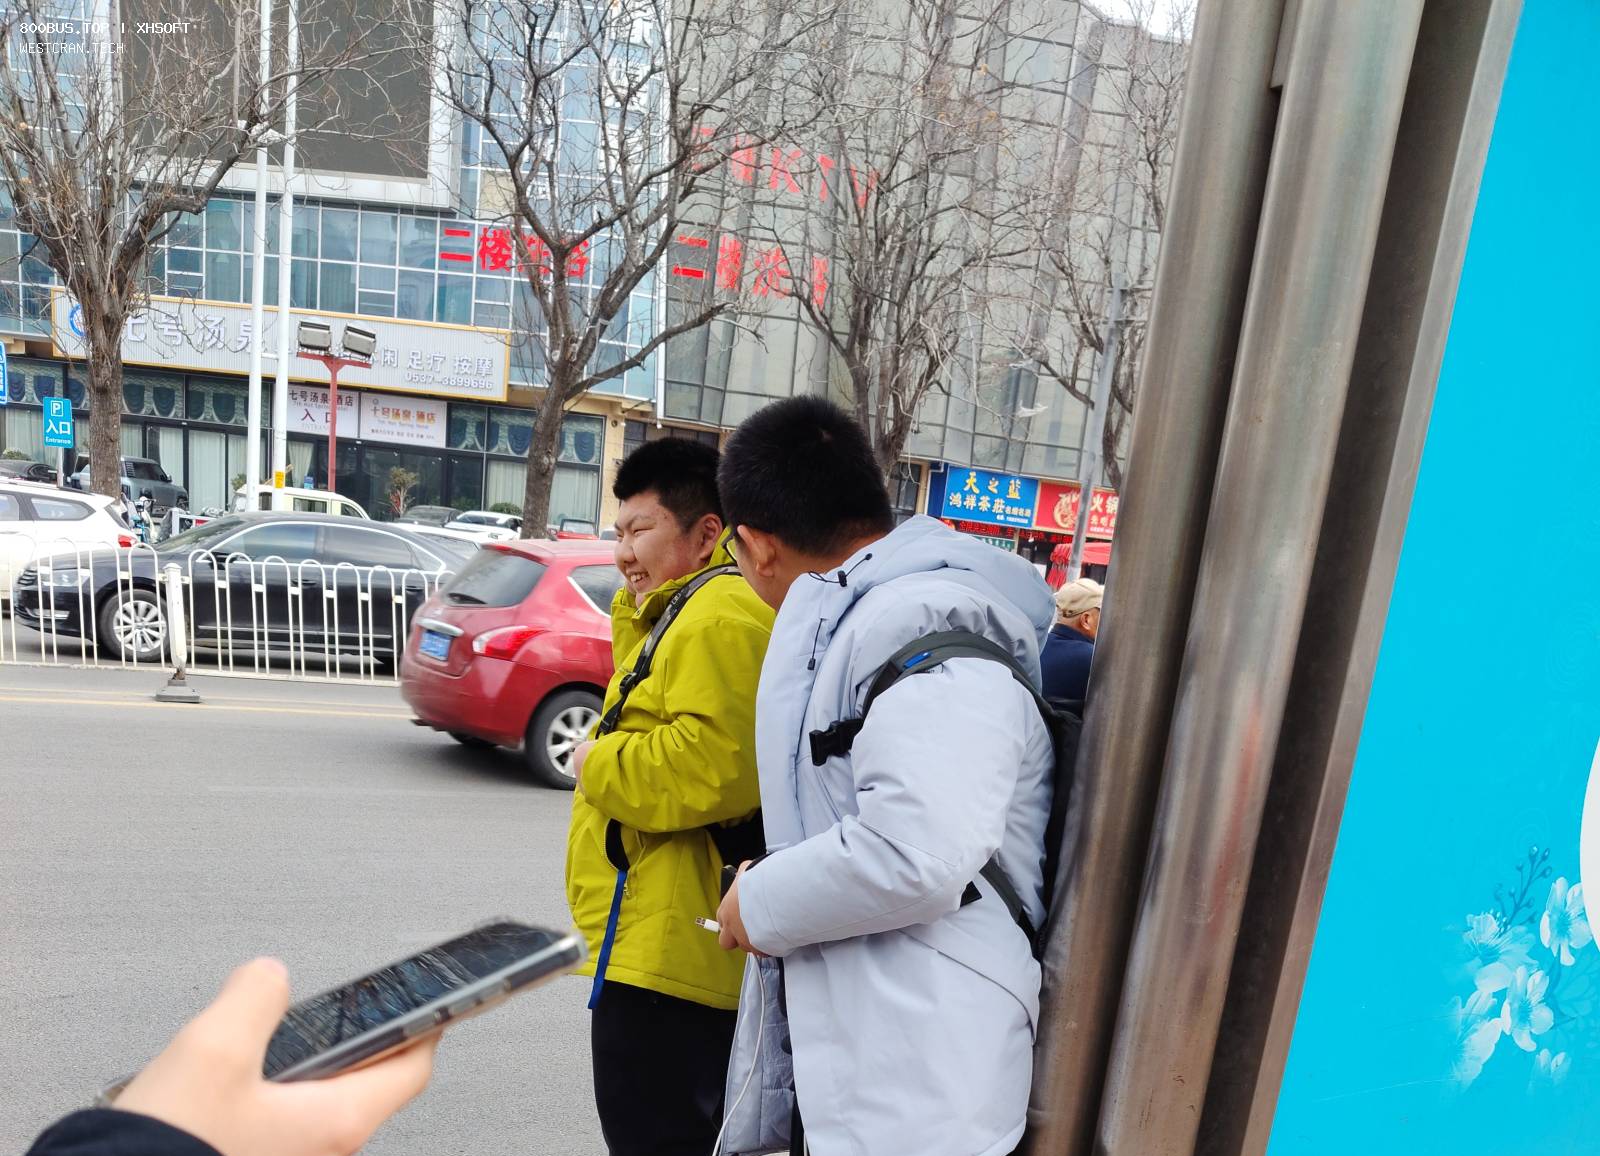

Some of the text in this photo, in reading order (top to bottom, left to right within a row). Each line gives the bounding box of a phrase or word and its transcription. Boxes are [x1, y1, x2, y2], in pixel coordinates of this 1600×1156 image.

[407, 350, 446, 373] 足疗
[454, 354, 495, 377] 按摩
[53, 403, 61, 414] P
[46, 419, 71, 435] 入口
[46, 436, 71, 444] Entrance
